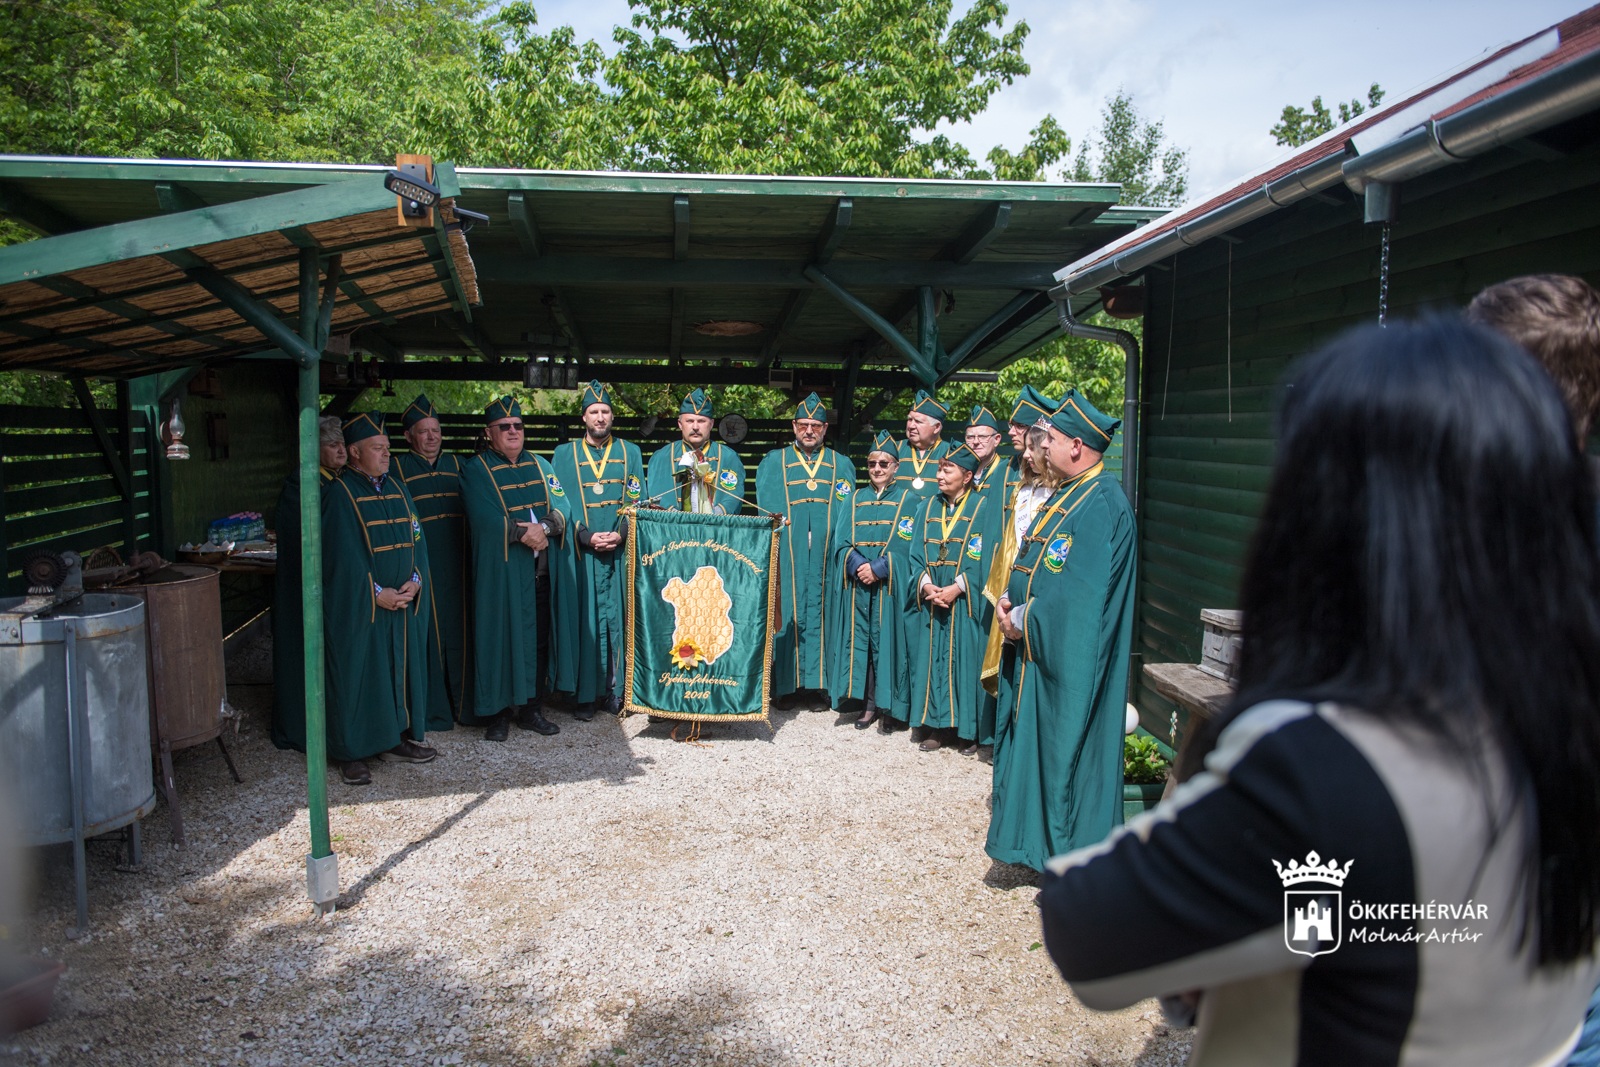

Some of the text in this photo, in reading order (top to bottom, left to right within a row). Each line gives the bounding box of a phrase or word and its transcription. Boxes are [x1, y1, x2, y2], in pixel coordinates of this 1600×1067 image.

[641, 545, 666, 566] Szent
[667, 538, 700, 551] István
[658, 672, 739, 687] Székesfehérvár
[683, 690, 711, 699] 2016
